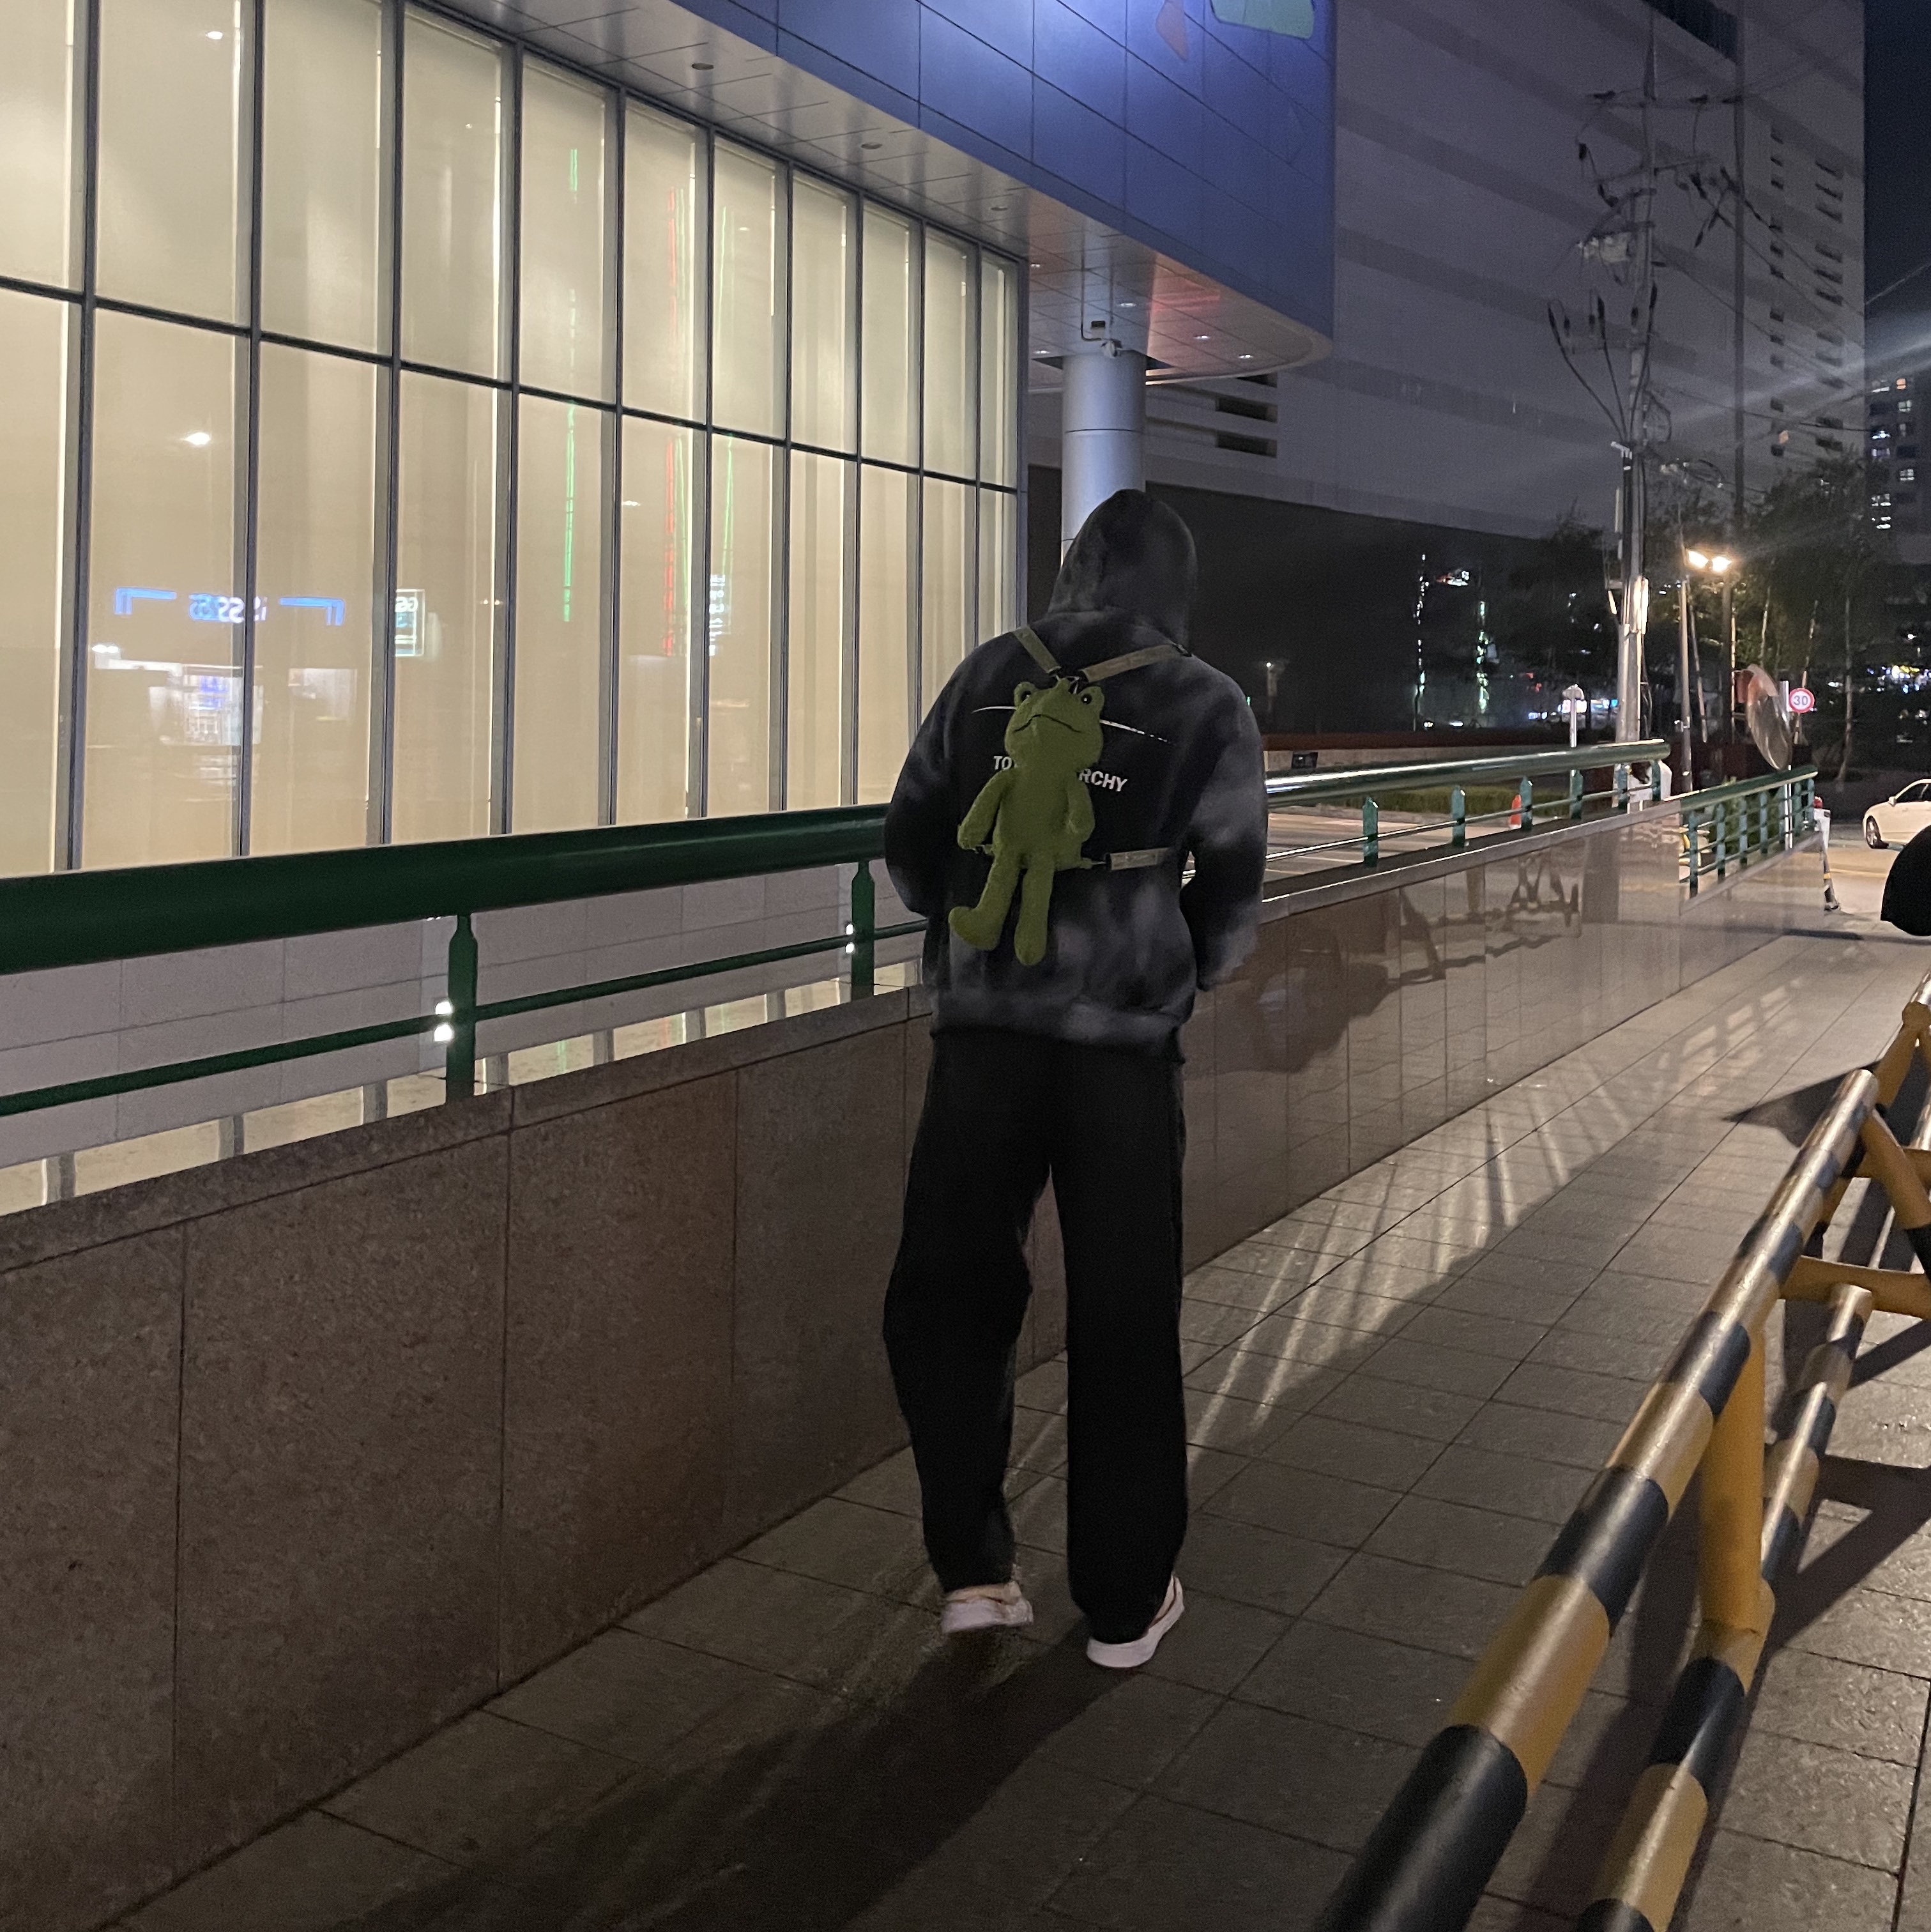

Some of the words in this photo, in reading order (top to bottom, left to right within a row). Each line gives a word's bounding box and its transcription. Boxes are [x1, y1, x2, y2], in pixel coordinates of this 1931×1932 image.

[1793, 695, 1808, 706] 30
[993, 755, 1016, 770] TO
[1078, 768, 1128, 792] RCHY
